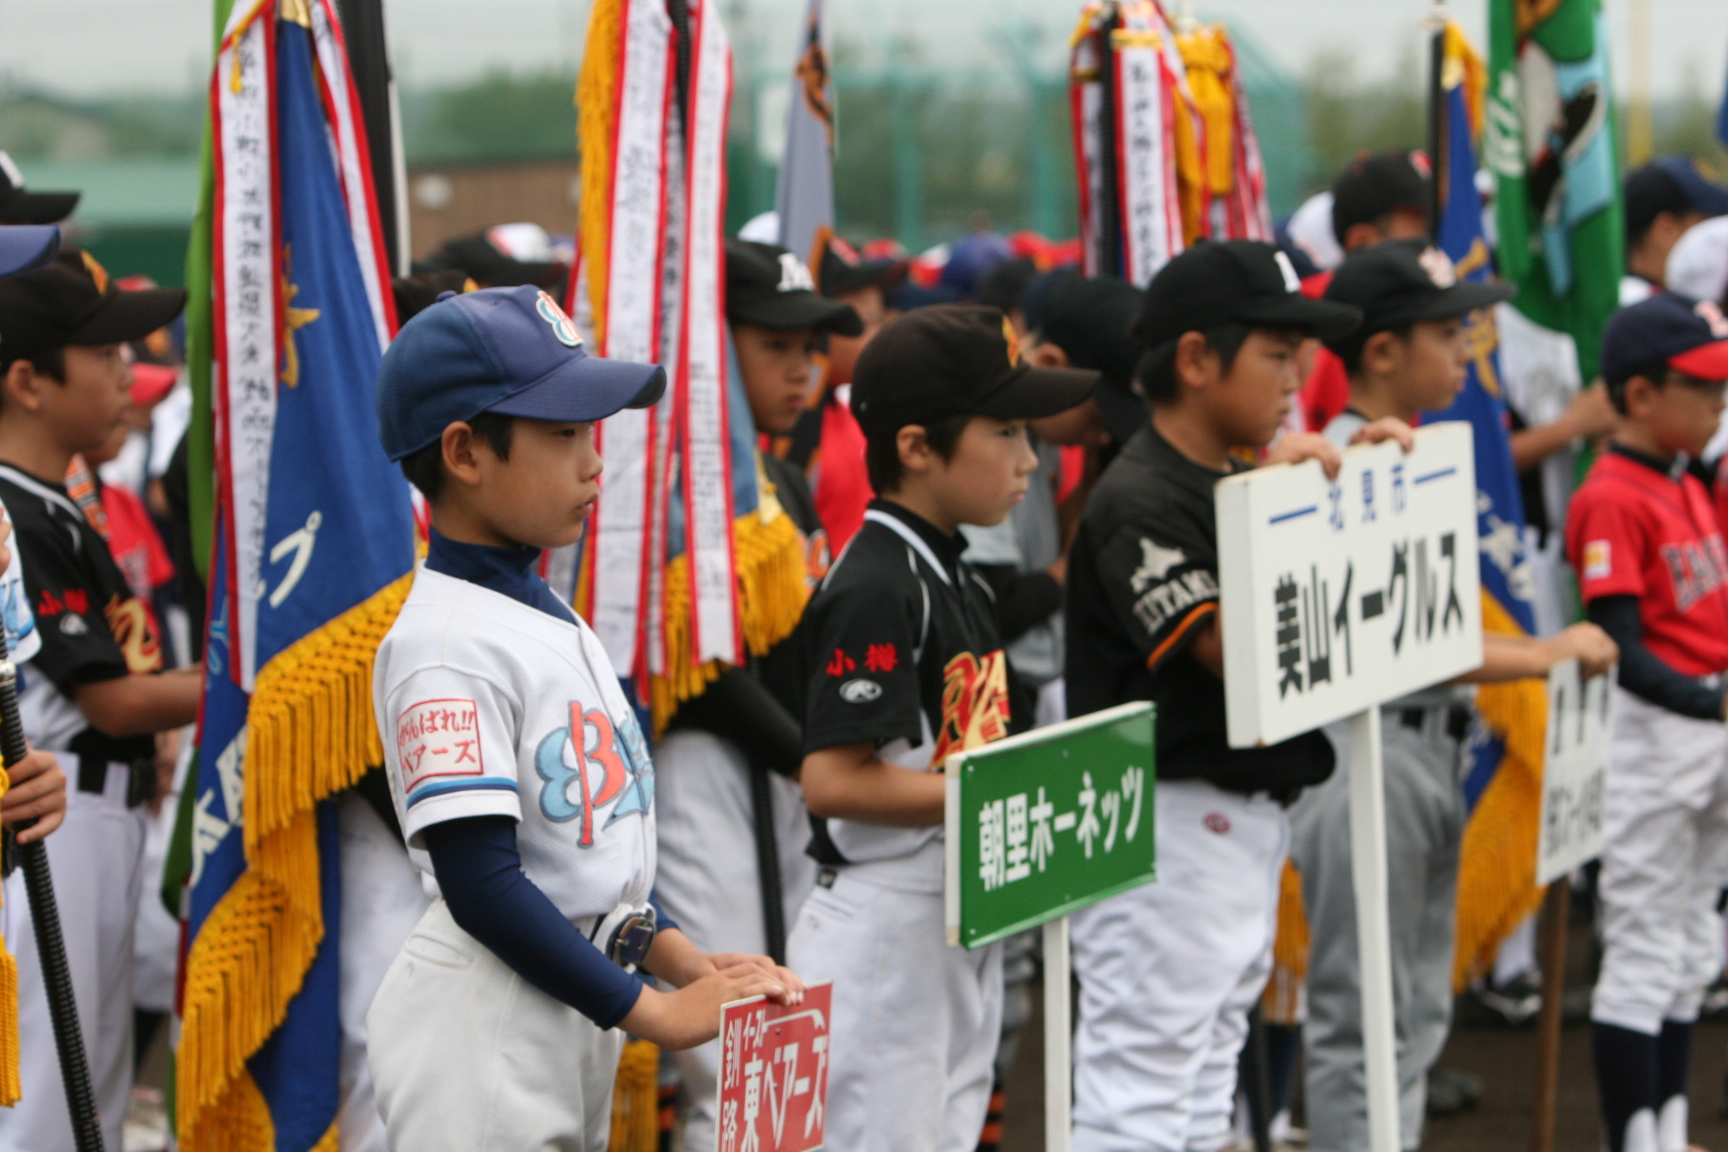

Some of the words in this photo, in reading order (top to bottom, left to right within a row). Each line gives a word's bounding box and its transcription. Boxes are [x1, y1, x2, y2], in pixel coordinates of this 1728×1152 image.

[1274, 529, 1464, 702] 美山イーグルス
[978, 765, 1145, 893] 朝里ホーネッツ
